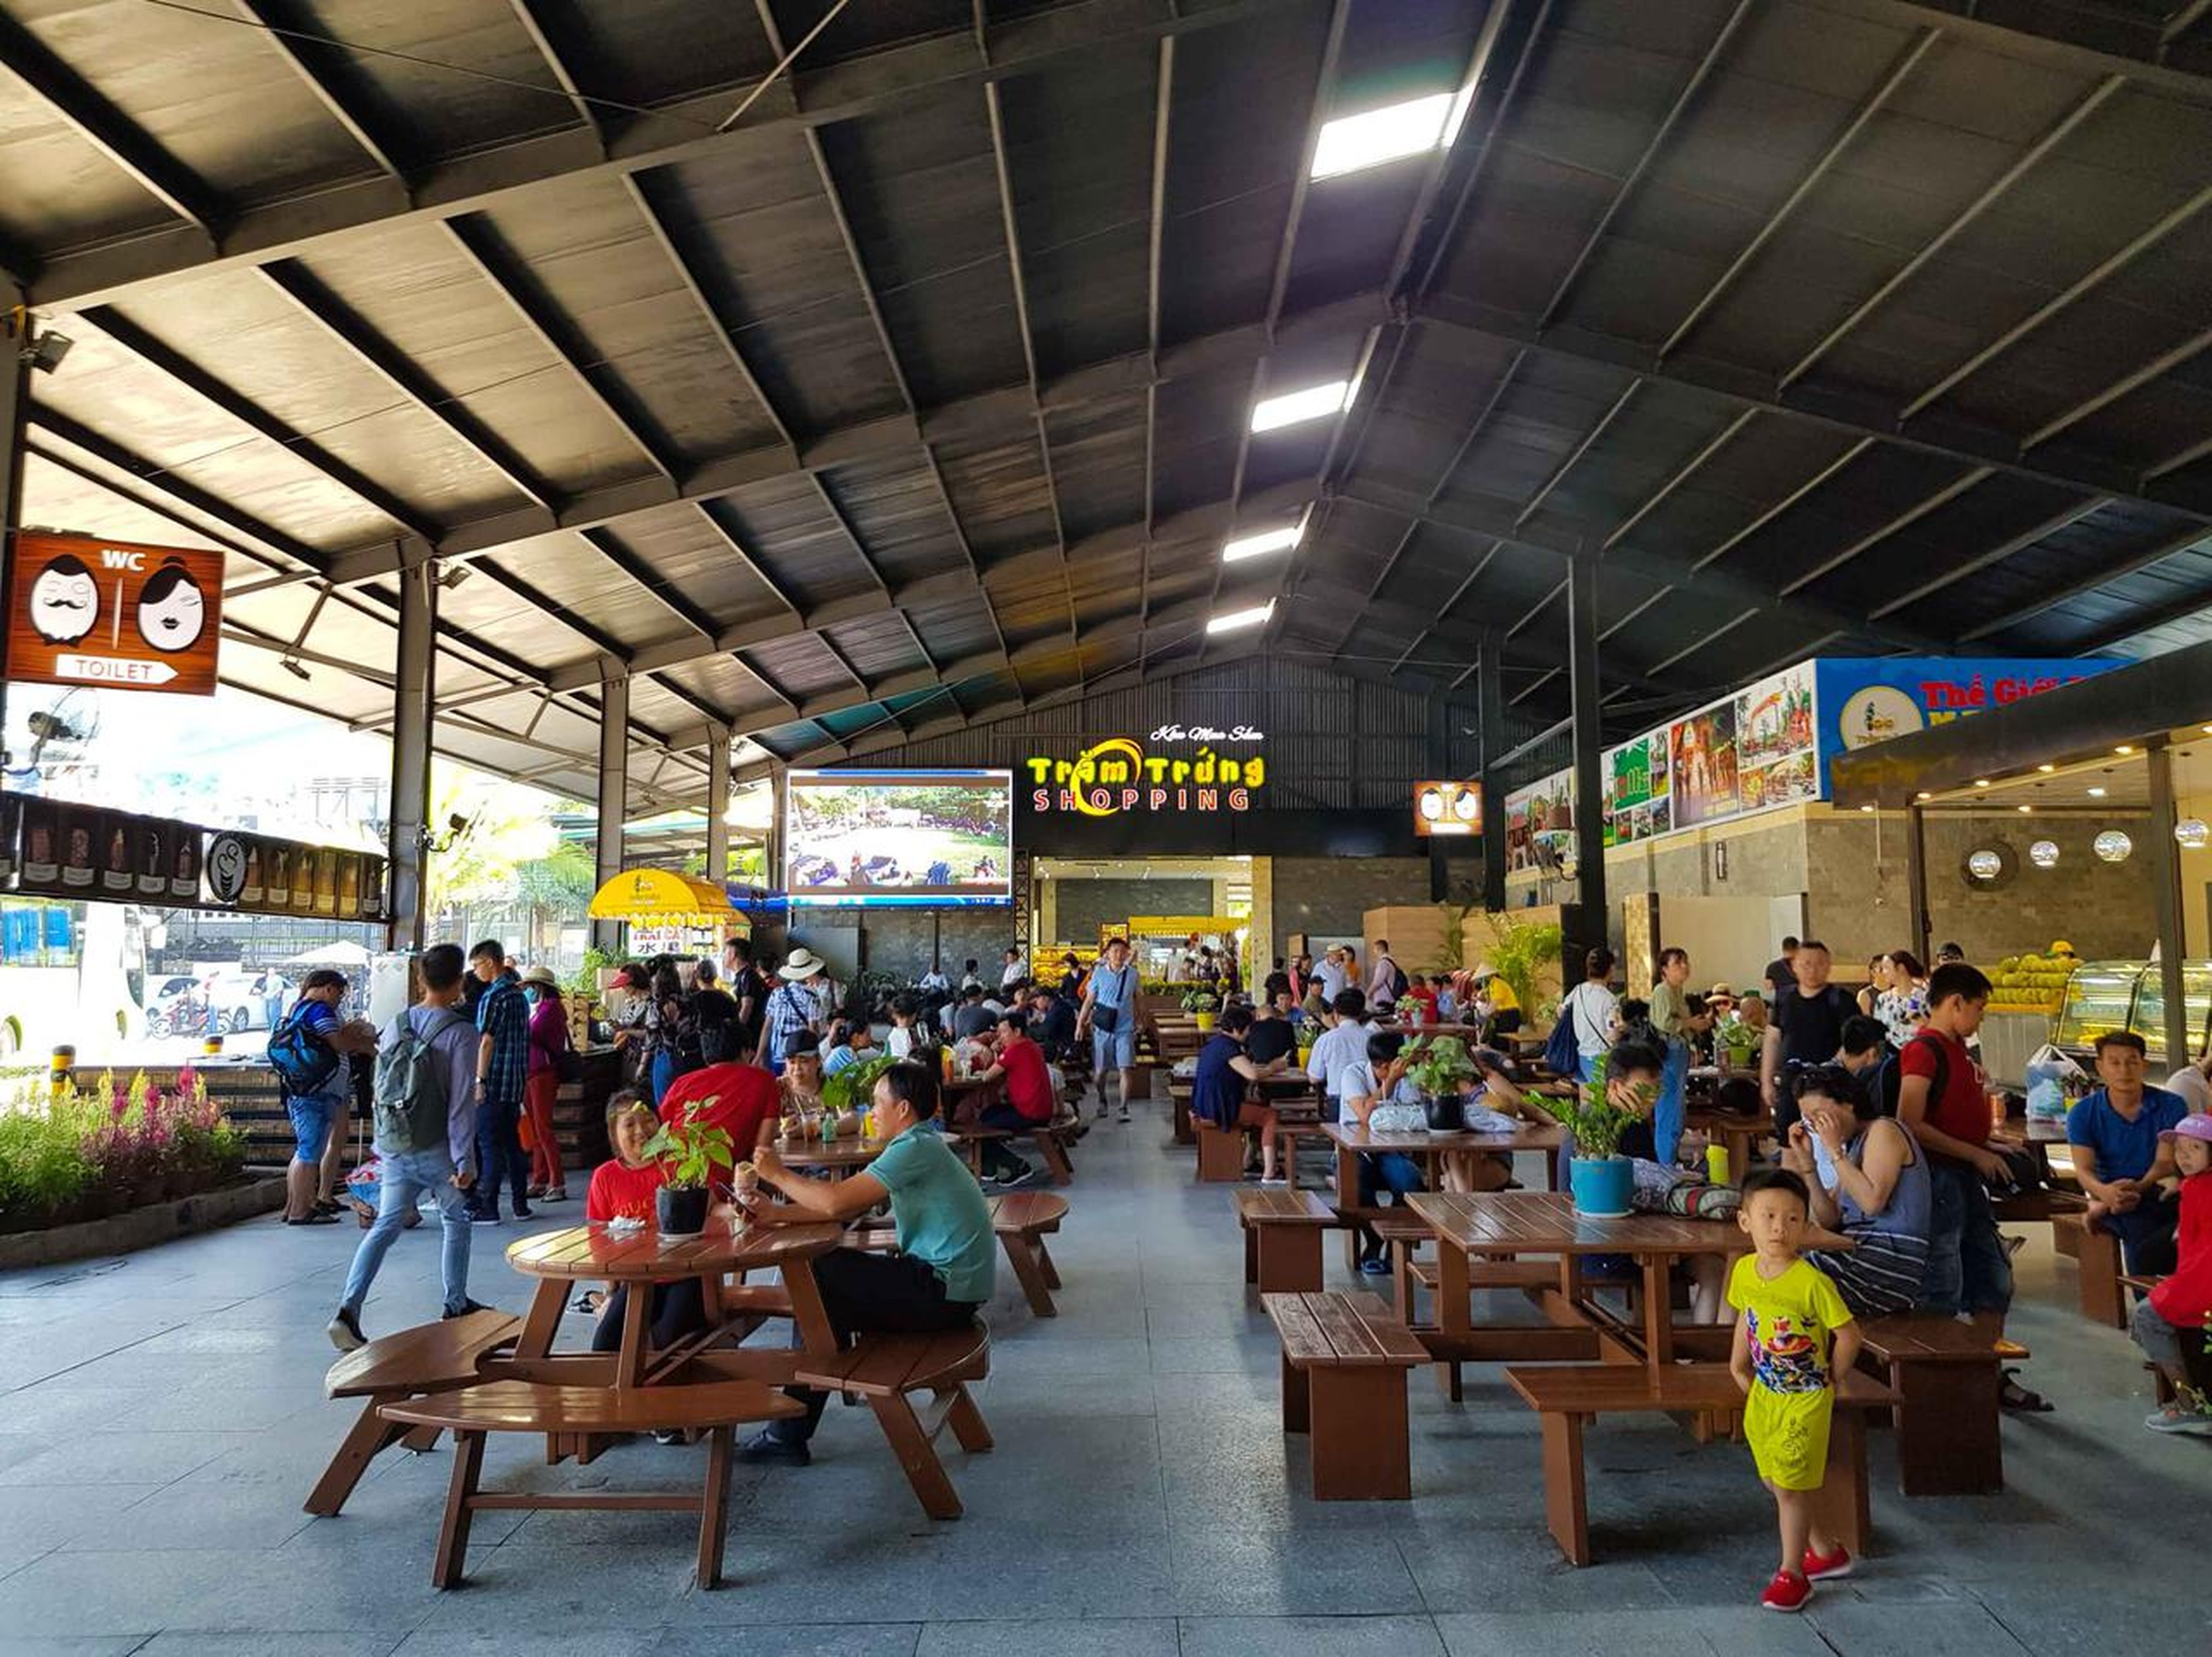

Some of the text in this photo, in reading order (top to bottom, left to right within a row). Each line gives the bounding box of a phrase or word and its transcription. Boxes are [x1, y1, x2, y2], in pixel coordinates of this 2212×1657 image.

[101, 549, 146, 571] WC
[75, 659, 152, 680] TOILET
[1027, 746, 1264, 787] Trăm Trứng
[1033, 788, 1249, 811] SHOPPING
